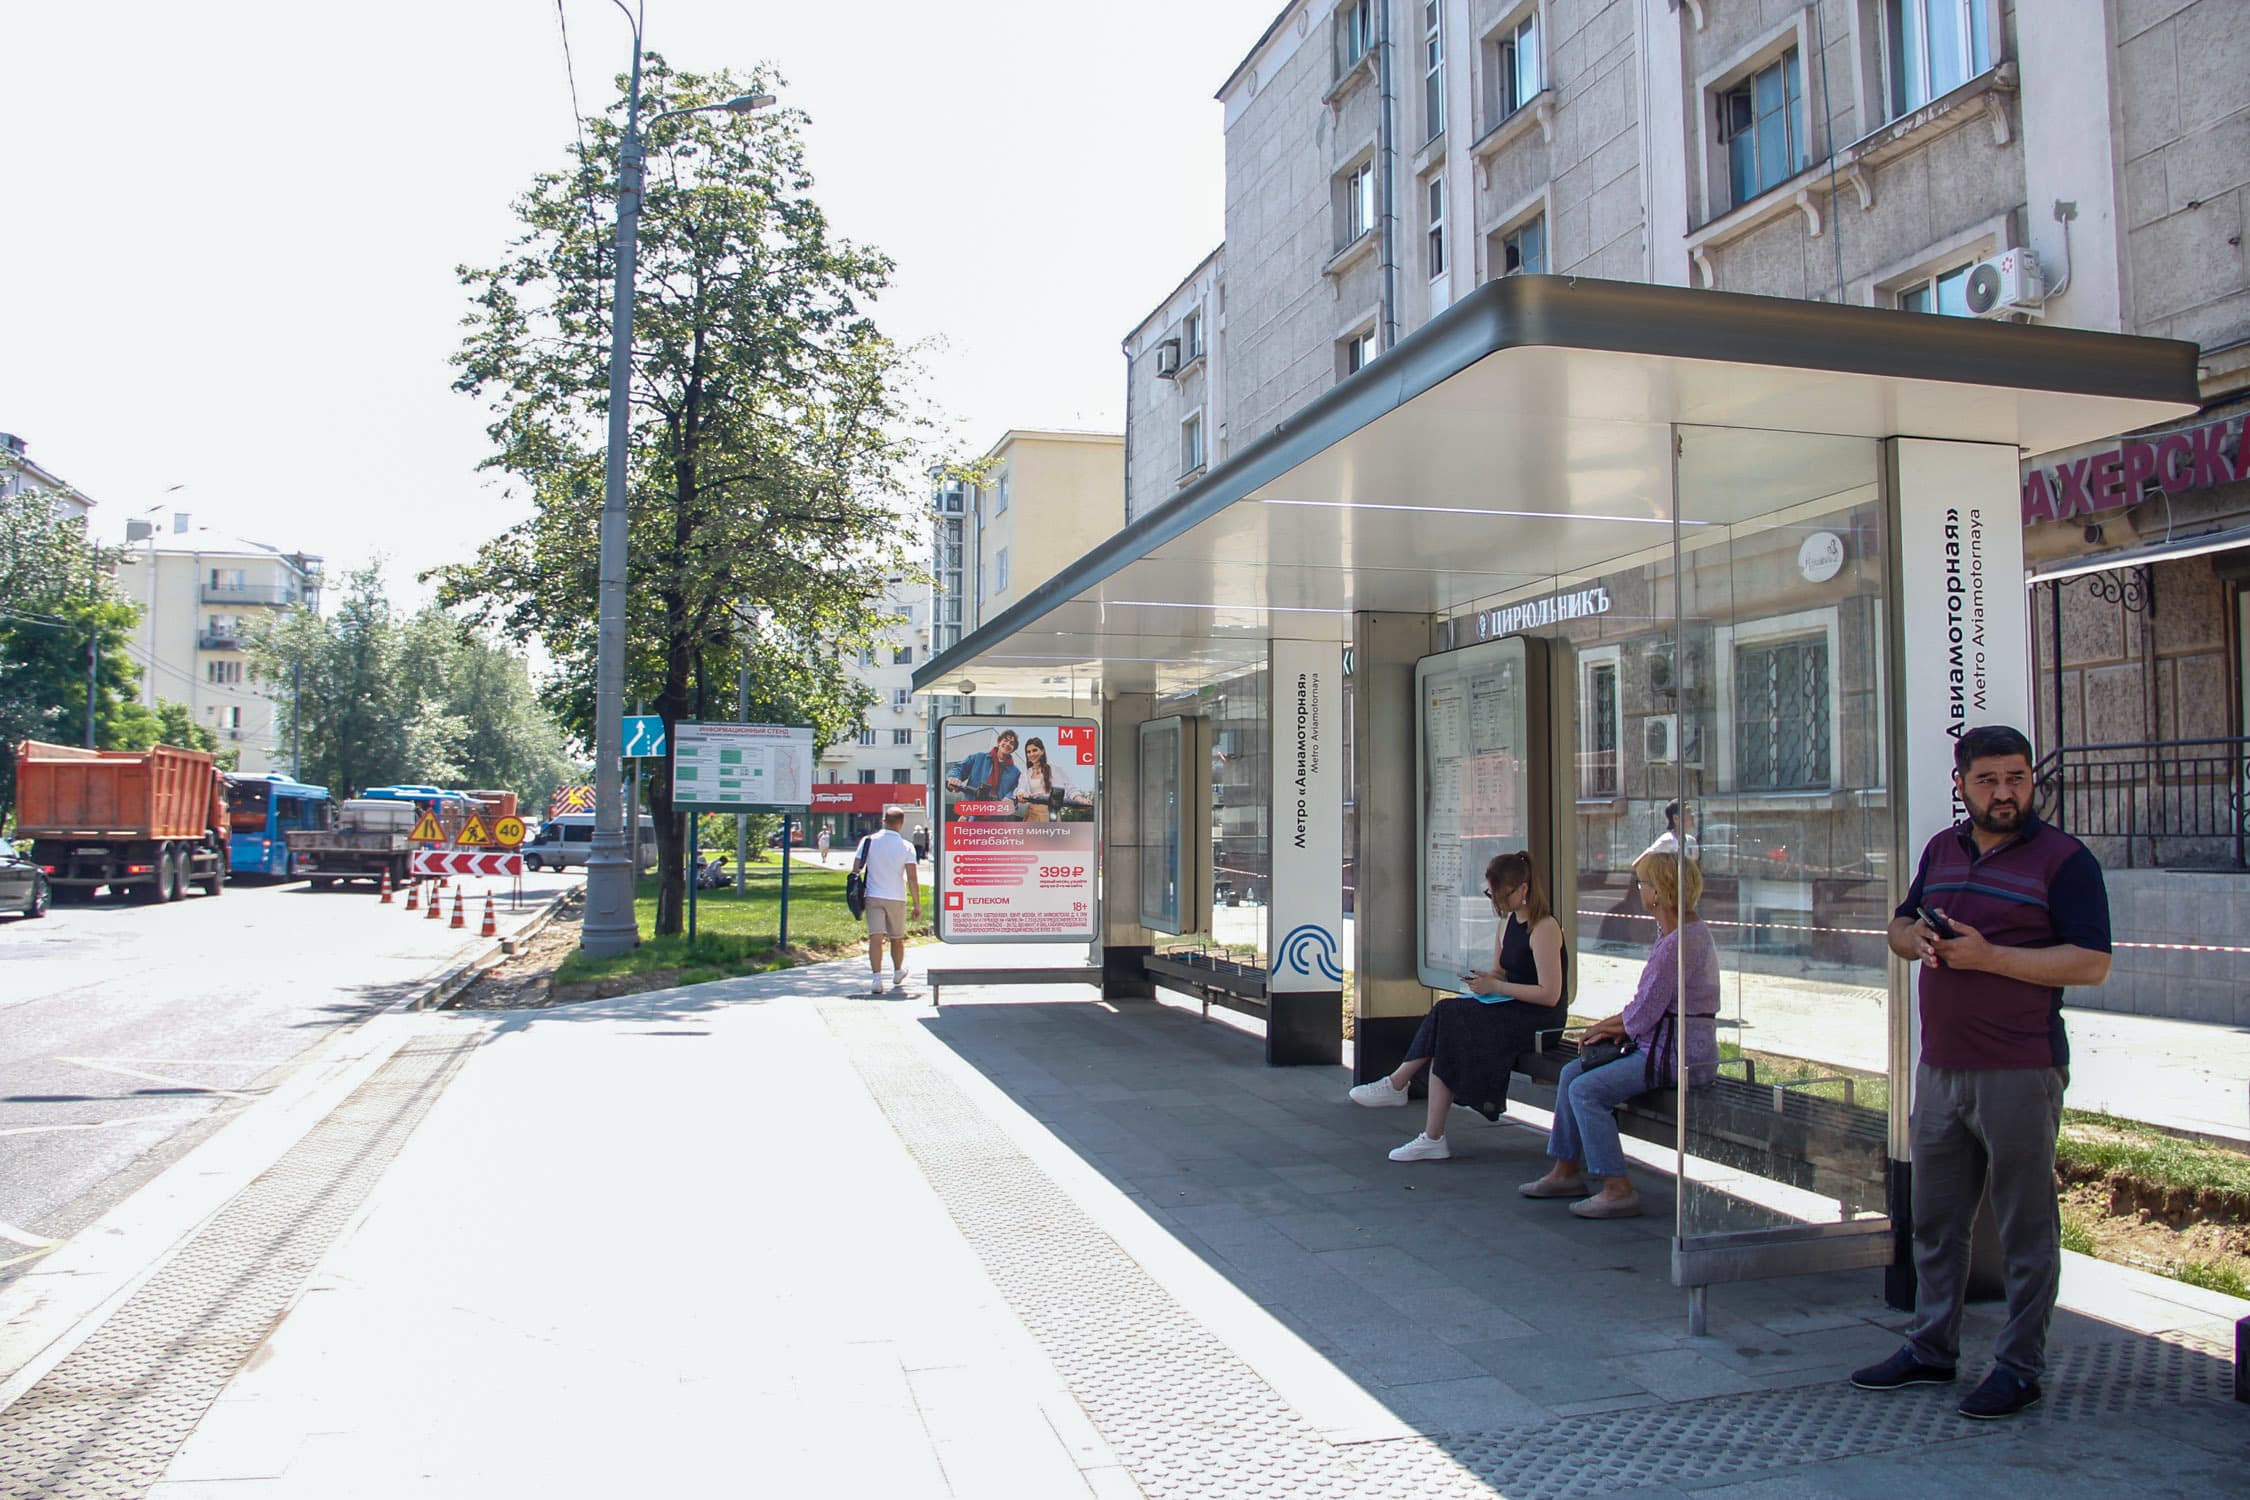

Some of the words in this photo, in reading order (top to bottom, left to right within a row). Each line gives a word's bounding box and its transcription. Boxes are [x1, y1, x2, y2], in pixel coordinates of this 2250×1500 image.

[1968, 508, 1986, 647] Aviamotornaya
[1491, 586, 1612, 638] ЦИРЮЛЬНИКЪ
[1972, 652, 1987, 711] Metro
[1310, 672, 1319, 742] Aviamotornaya
[767, 727, 789, 736] СТЕНД
[1295, 673, 1309, 796] «Авиамоторная»
[1310, 744, 1320, 774] Metro
[960, 803, 996, 813] ТАРИФ
[997, 803, 1010, 812] 24
[499, 824, 520, 837] 40
[953, 826, 1024, 836] Переносите
[1026, 828, 1071, 837] минуты
[1294, 799, 1309, 849] Метро
[963, 836, 1025, 846] гигабайты
[967, 897, 1010, 905] ТЕЛЕКОМ
[1072, 901, 1088, 912] 18+
